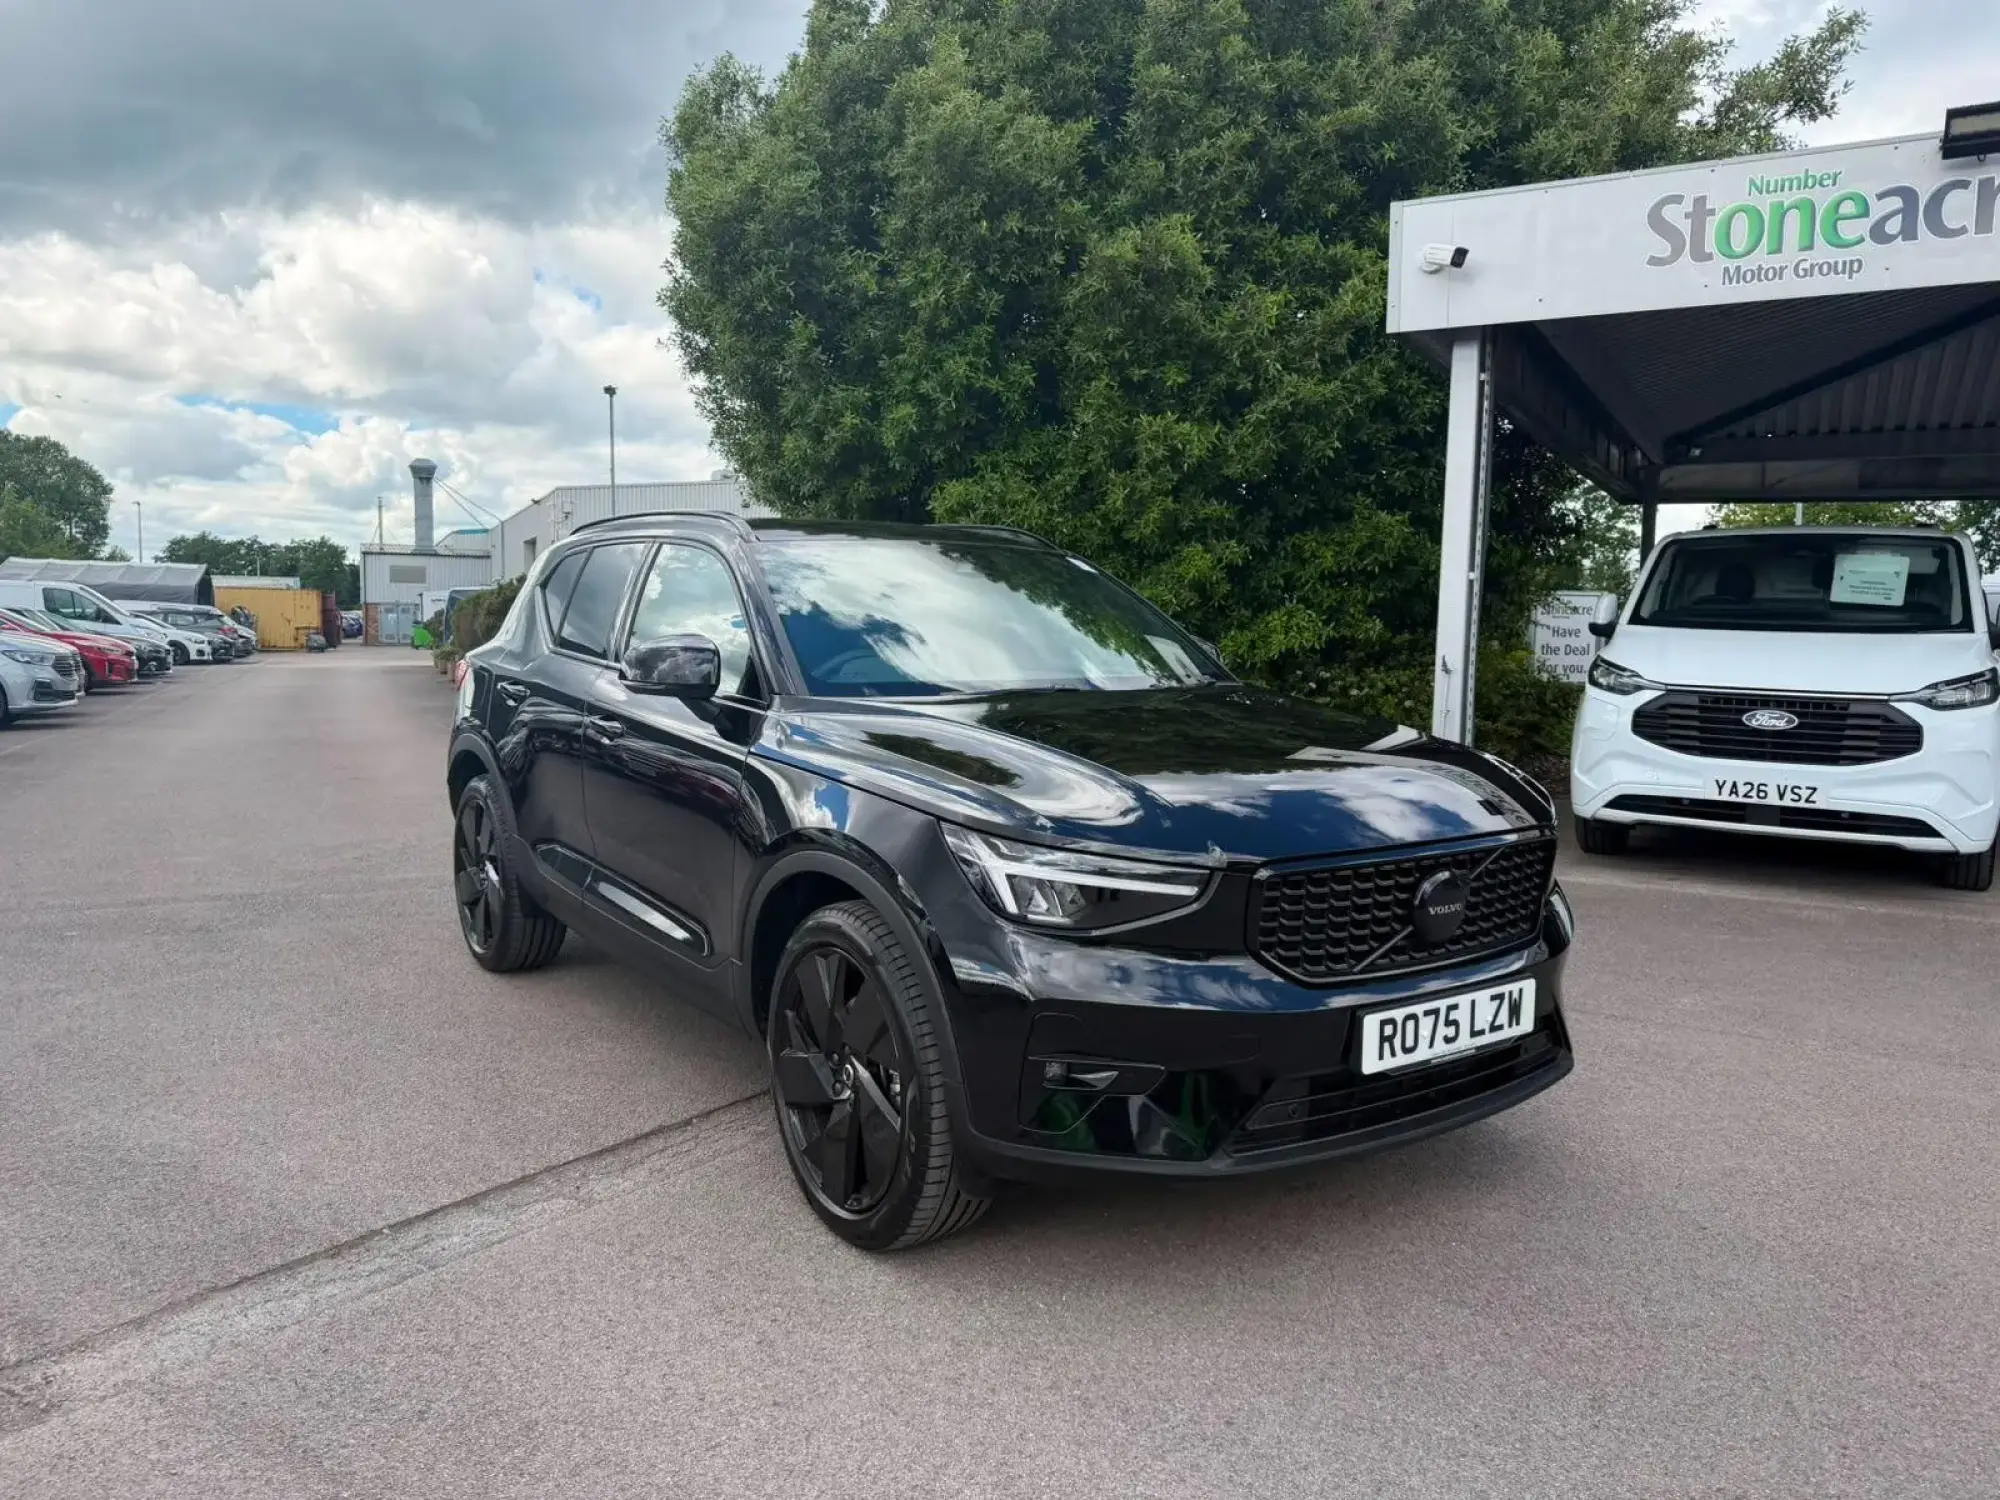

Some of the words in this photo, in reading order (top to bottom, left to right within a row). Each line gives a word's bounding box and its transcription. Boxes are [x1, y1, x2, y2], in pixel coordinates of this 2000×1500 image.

[1748, 168, 1842, 196] Number
[1721, 263, 1787, 286] Motor
[1793, 257, 1864, 280] Group
[1551, 626, 1582, 638] Have
[1540, 643, 1561, 656] the
[1564, 643, 1591, 656] Deal
[1750, 711, 1791, 728] Ford
[1714, 779, 1769, 800] YA26
[1776, 784, 1819, 804] VSZ
[1427, 903, 1463, 916] VOLVO
[1378, 1003, 1461, 1061] RO75
[1469, 987, 1524, 1039] LZW
